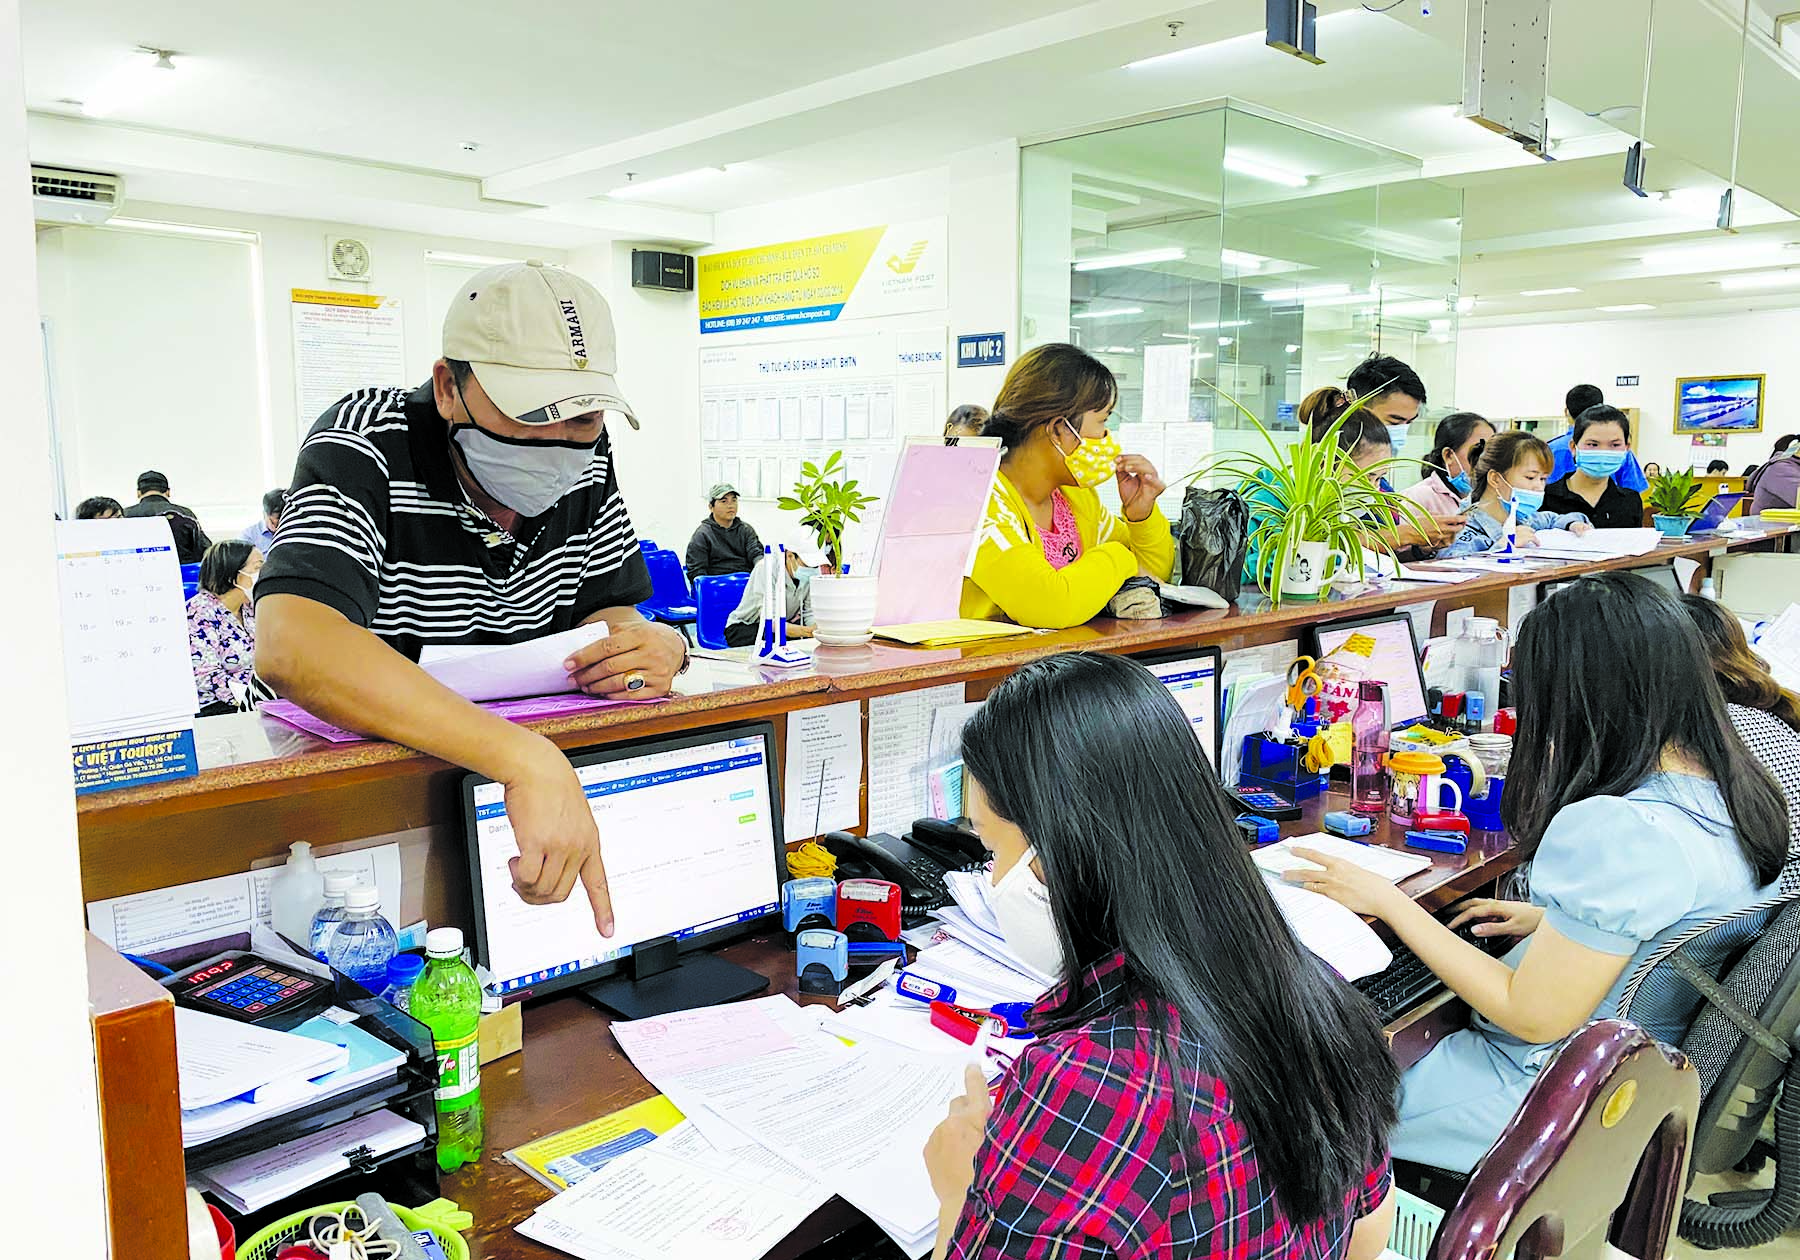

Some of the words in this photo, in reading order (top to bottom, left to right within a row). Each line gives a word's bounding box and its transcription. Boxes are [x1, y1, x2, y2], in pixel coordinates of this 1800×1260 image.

[559, 299, 587, 358] ARMANI
[961, 342, 977, 359] KHU
[978, 338, 995, 361] VỰC
[996, 339, 1002, 357] 2
[86, 749, 116, 765] VIỆT
[119, 742, 174, 760] TOURIST
[488, 824, 509, 834] Danh
